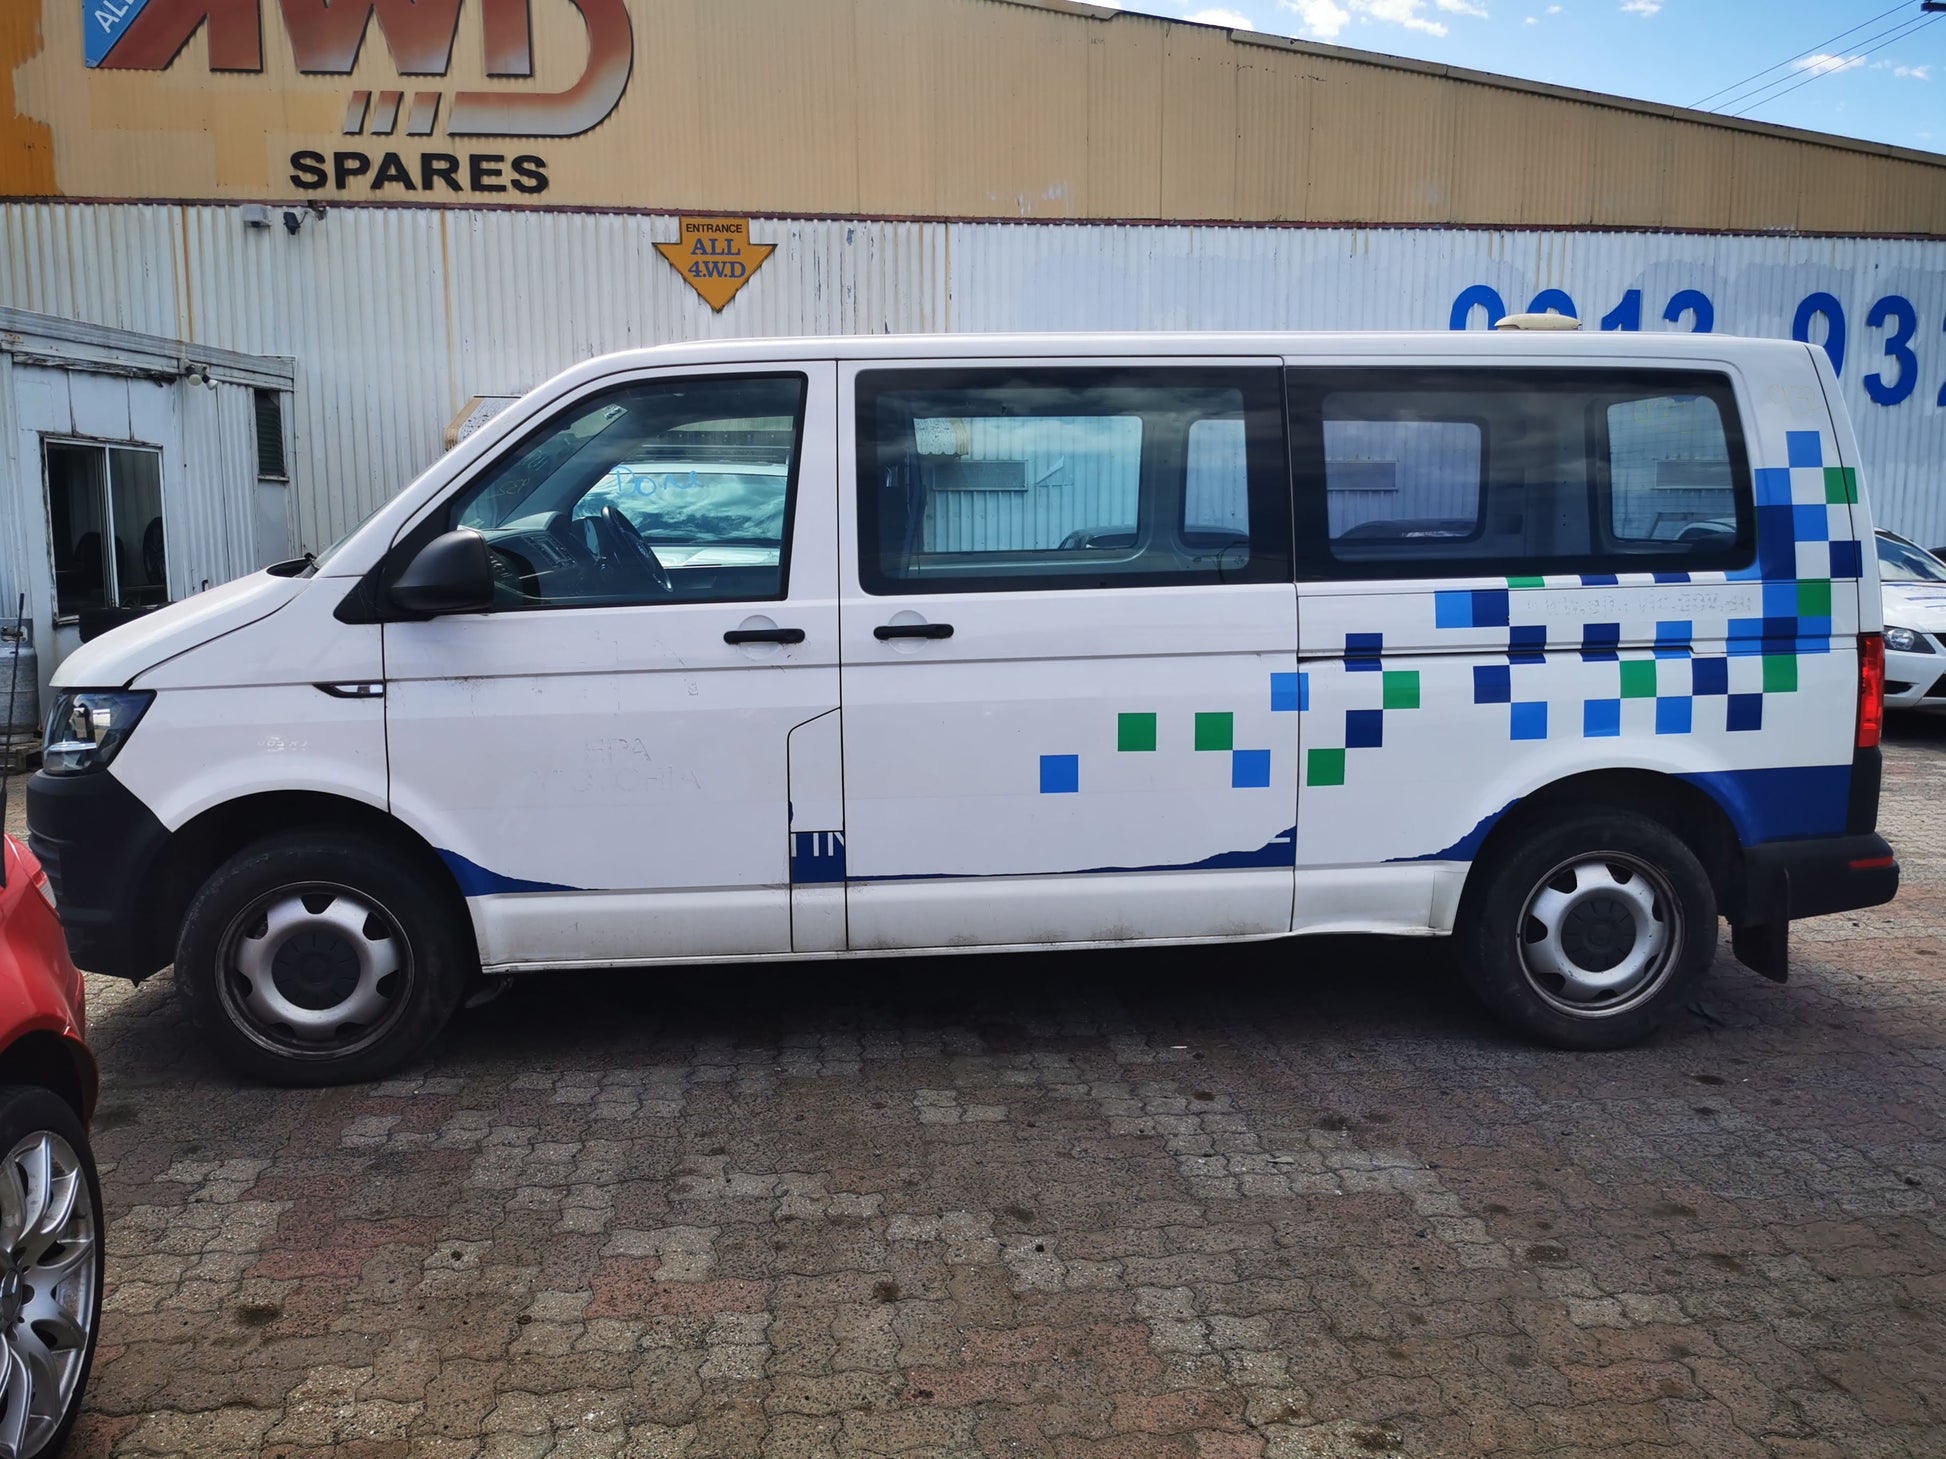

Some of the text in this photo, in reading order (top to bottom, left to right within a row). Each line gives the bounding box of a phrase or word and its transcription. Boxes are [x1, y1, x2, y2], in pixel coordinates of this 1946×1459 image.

[95, 0, 135, 33] AL
[290, 150, 549, 194] SPARES
[686, 224, 743, 233] ENTRANCE
[691, 238, 741, 256] ALL
